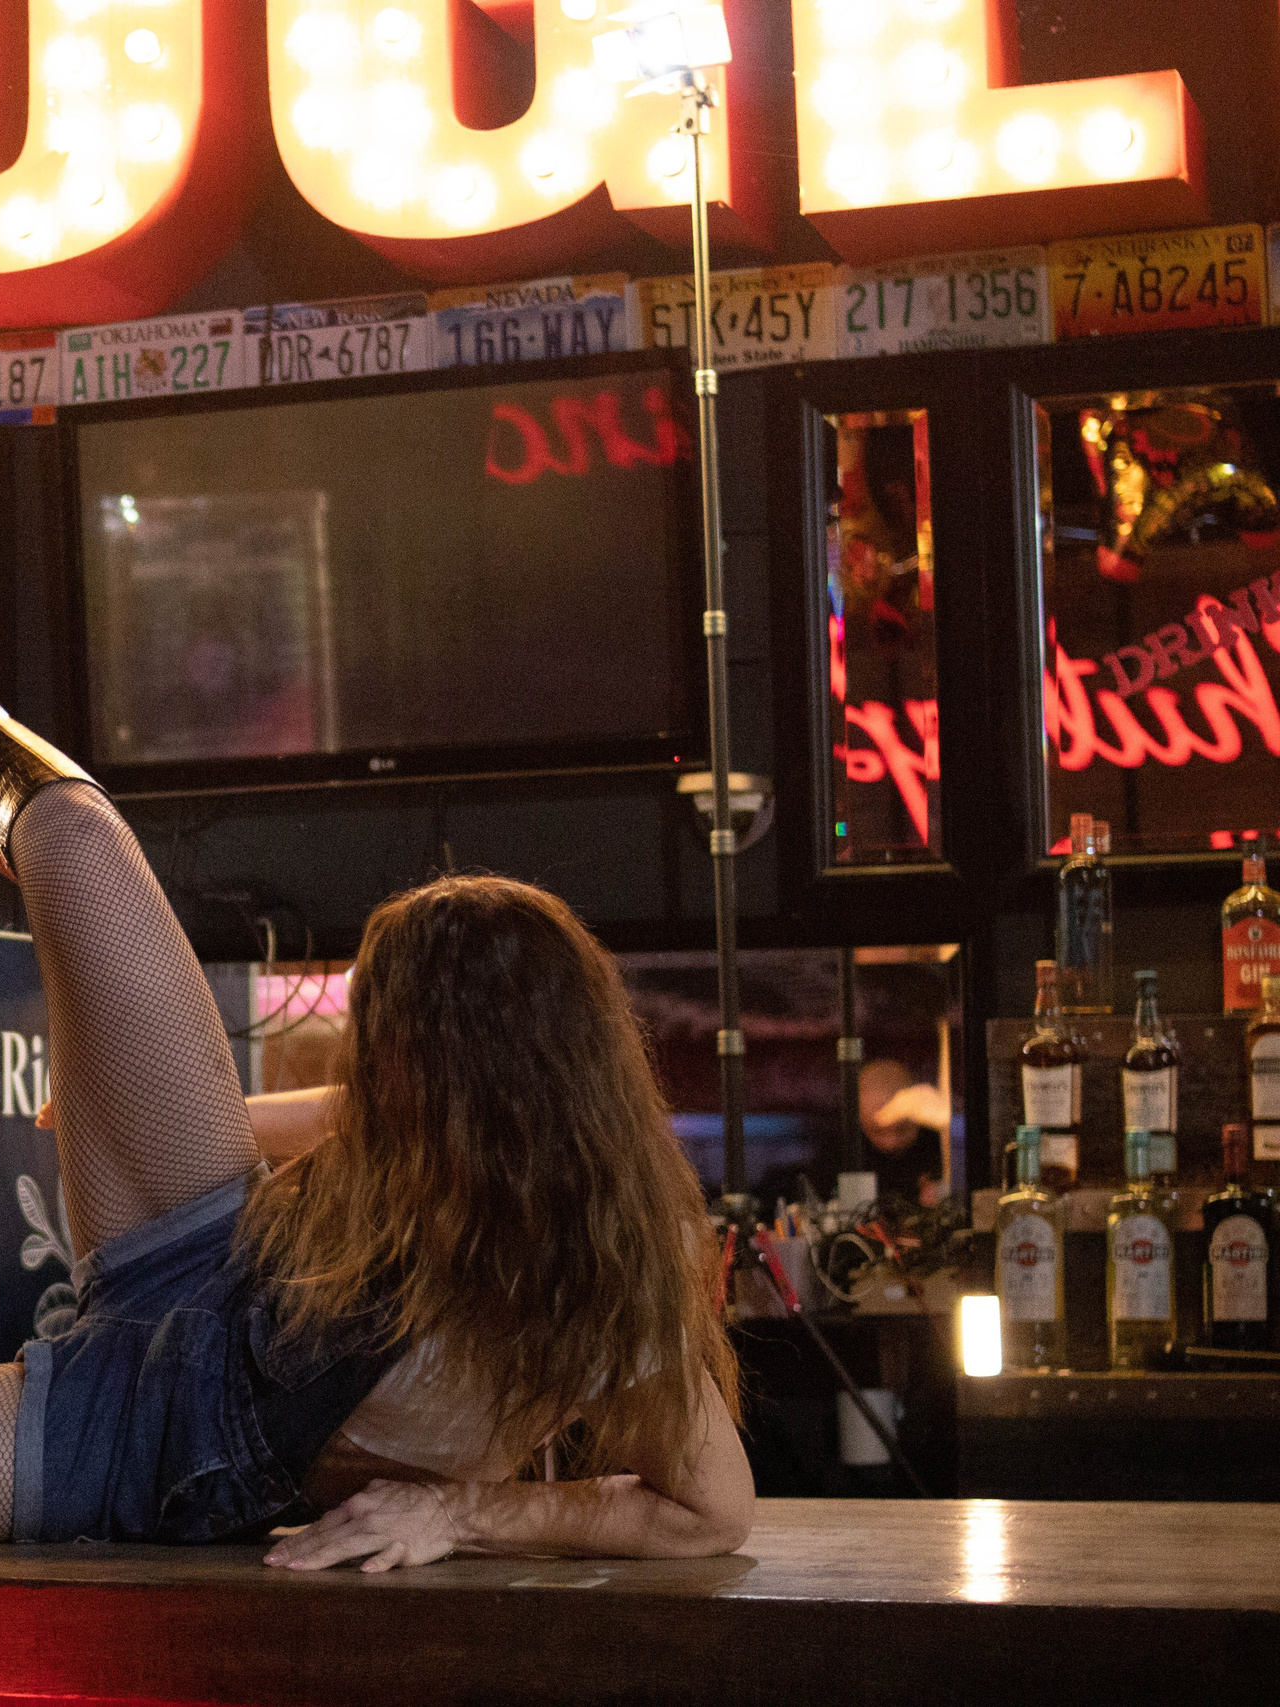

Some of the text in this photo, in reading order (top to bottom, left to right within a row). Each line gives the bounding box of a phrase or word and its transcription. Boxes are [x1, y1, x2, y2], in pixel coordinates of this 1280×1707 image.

[486, 284, 576, 309] NEVADA
[846, 267, 1037, 333] 217 1356
[100, 323, 200, 346] OKLAHOMA
[171, 340, 230, 391] 227
